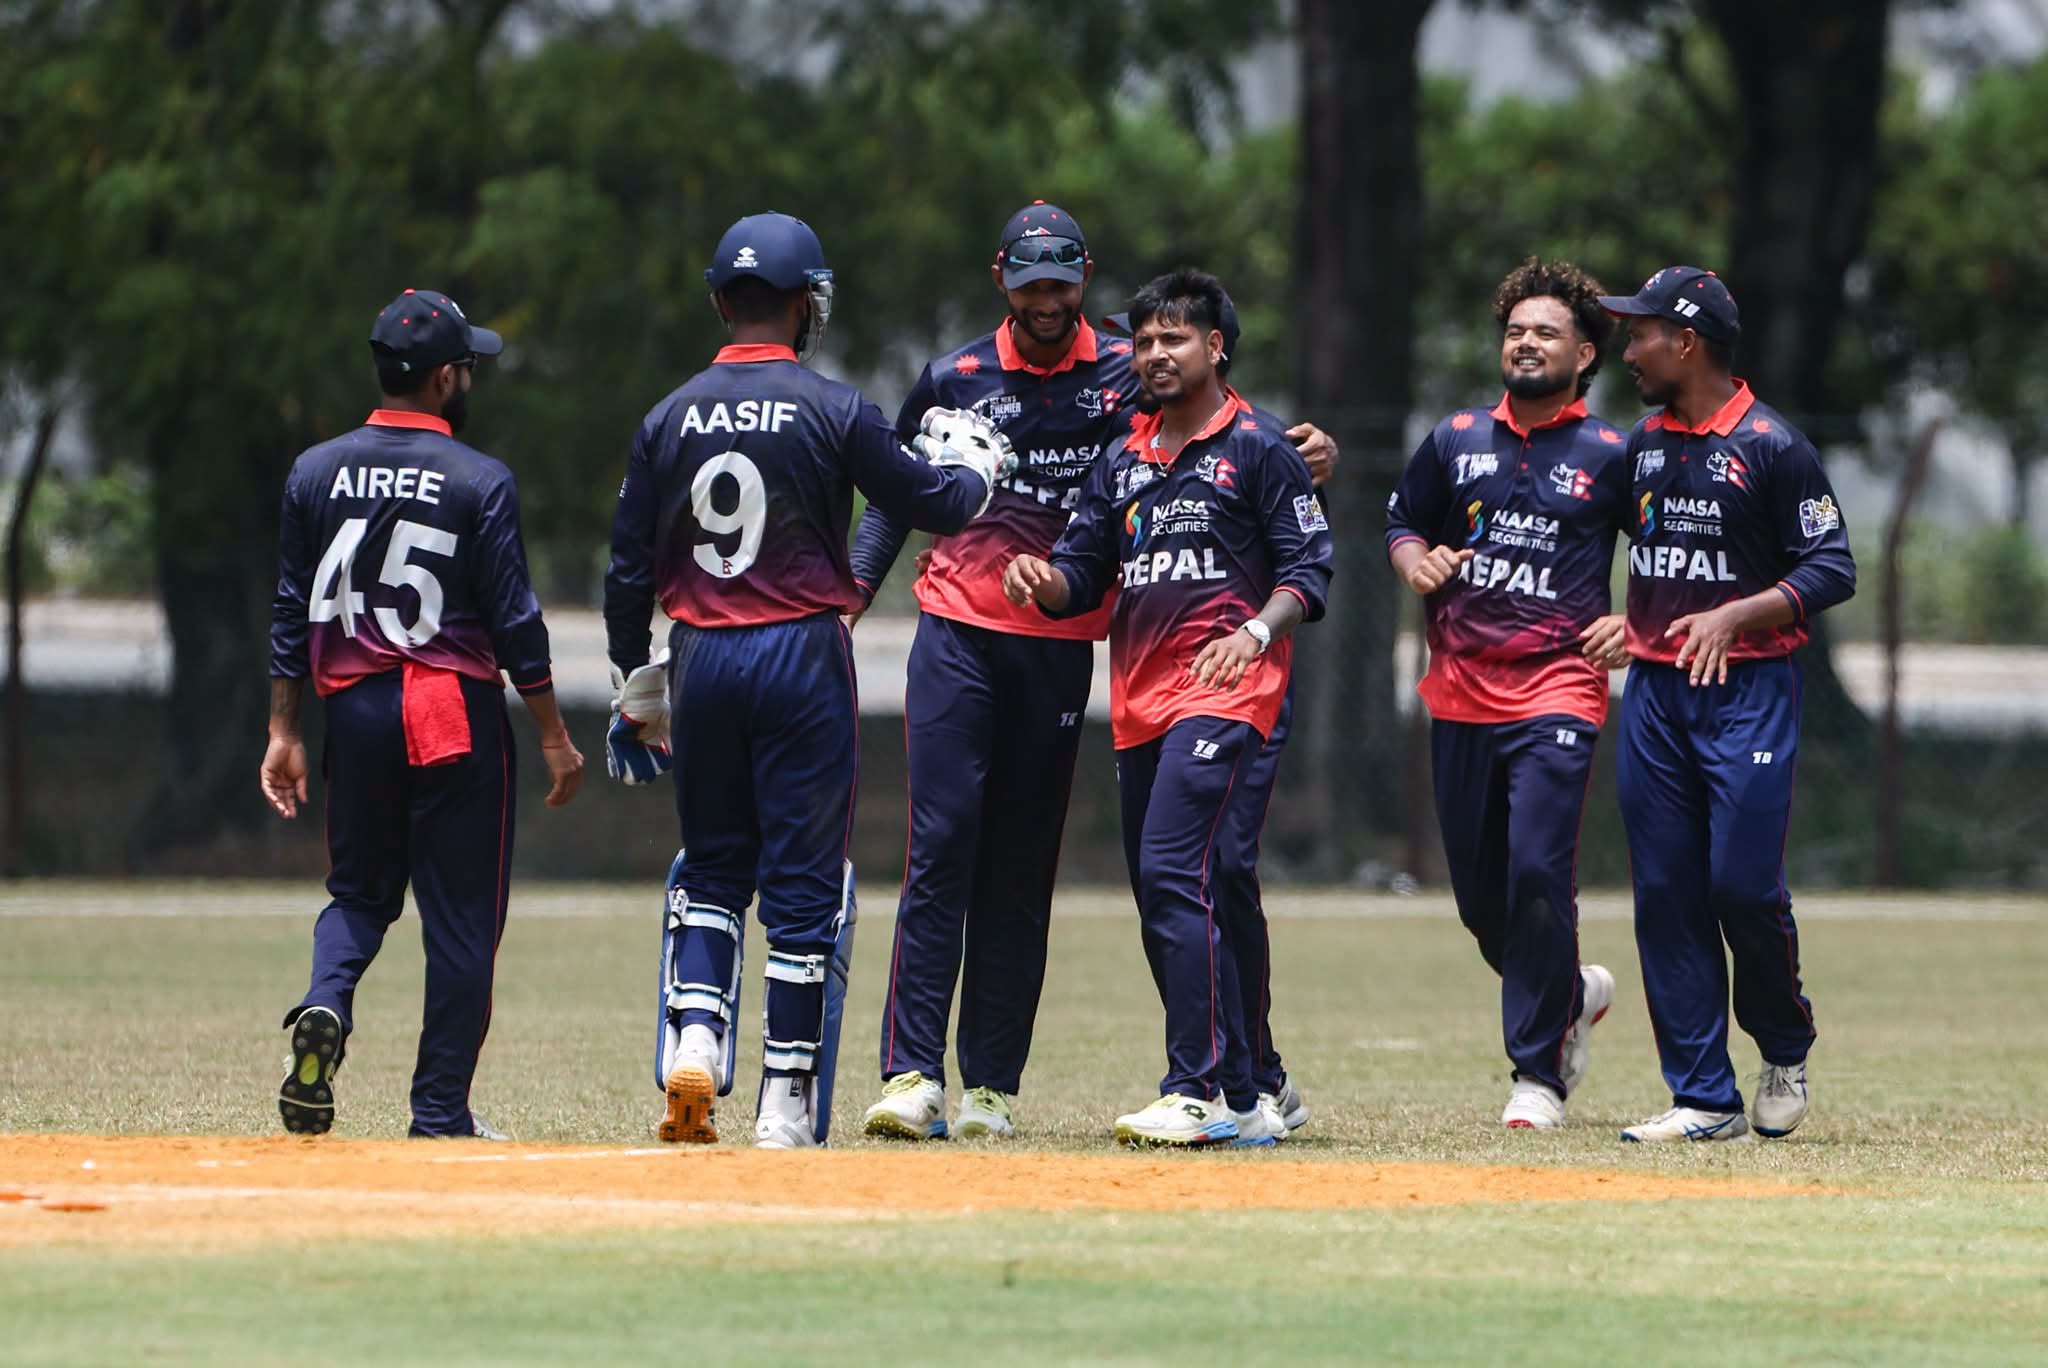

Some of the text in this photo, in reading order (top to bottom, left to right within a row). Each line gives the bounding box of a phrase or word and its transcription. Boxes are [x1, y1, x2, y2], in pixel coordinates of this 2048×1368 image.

[680, 400, 798, 437] AASIF
[1029, 444, 1100, 465] NAASA
[329, 466, 446, 505] AIREE
[691, 451, 766, 579] 9
[1491, 509, 1560, 535] NAASA
[1663, 497, 1722, 519] NAASA
[1630, 545, 1737, 582] NEPAL
[308, 518, 459, 649] 45
